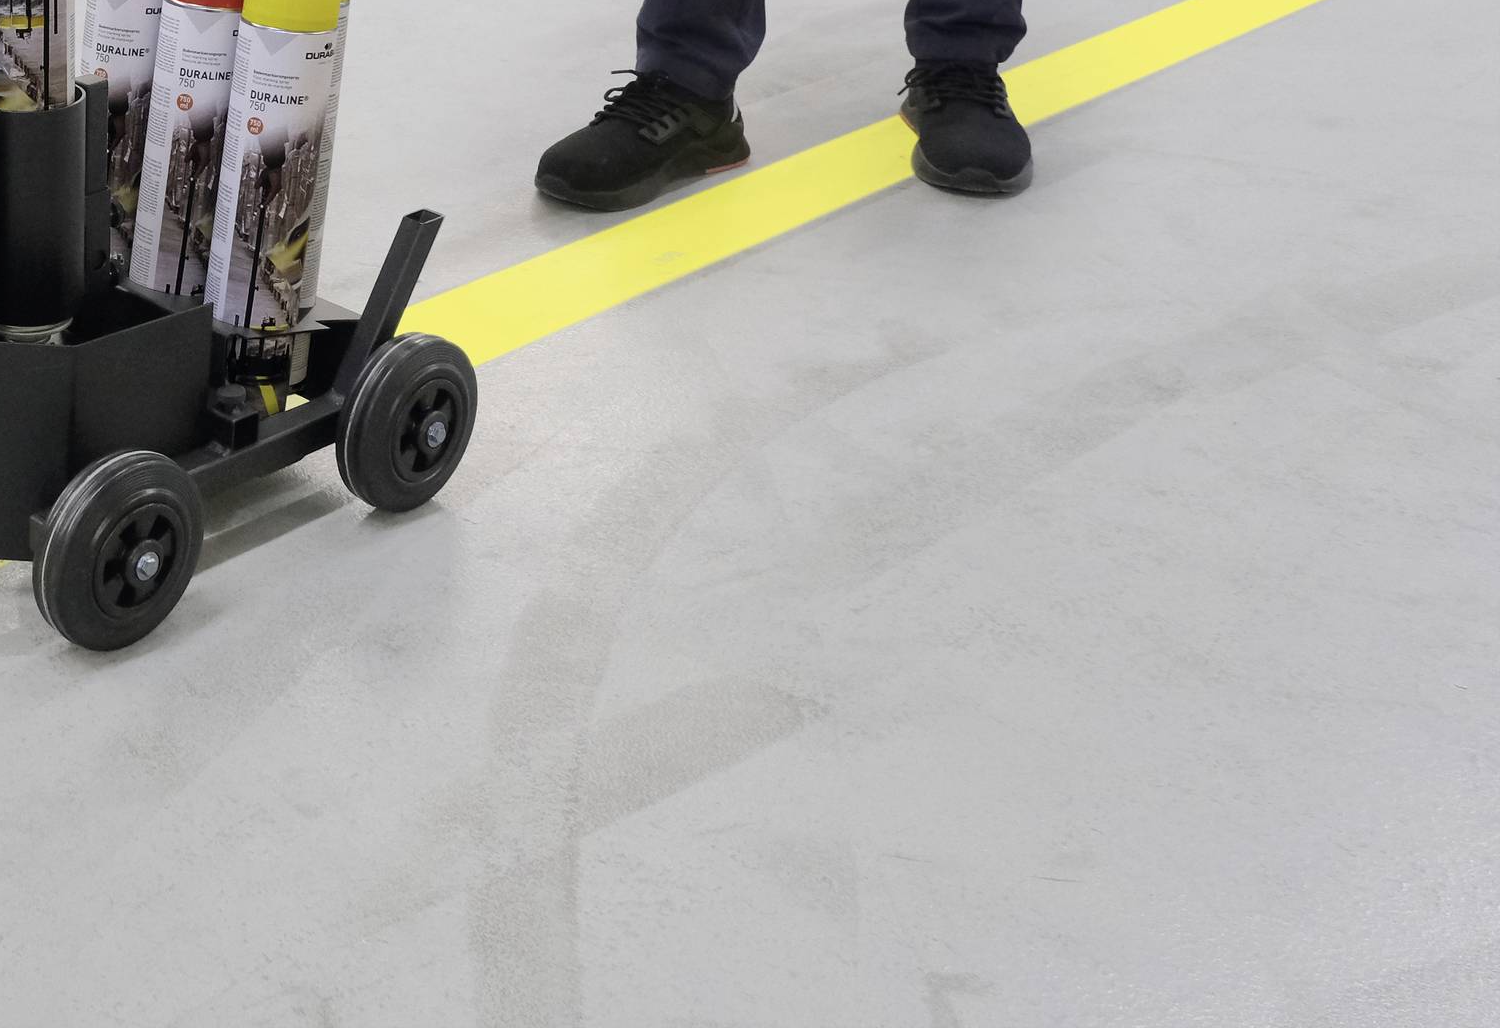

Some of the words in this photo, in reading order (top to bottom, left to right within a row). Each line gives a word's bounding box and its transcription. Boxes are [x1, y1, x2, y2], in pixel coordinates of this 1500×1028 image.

[95, 52, 110, 63] 750
[179, 67, 233, 81] DURALINE
[179, 77, 195, 88] 750
[249, 100, 266, 112] 750
